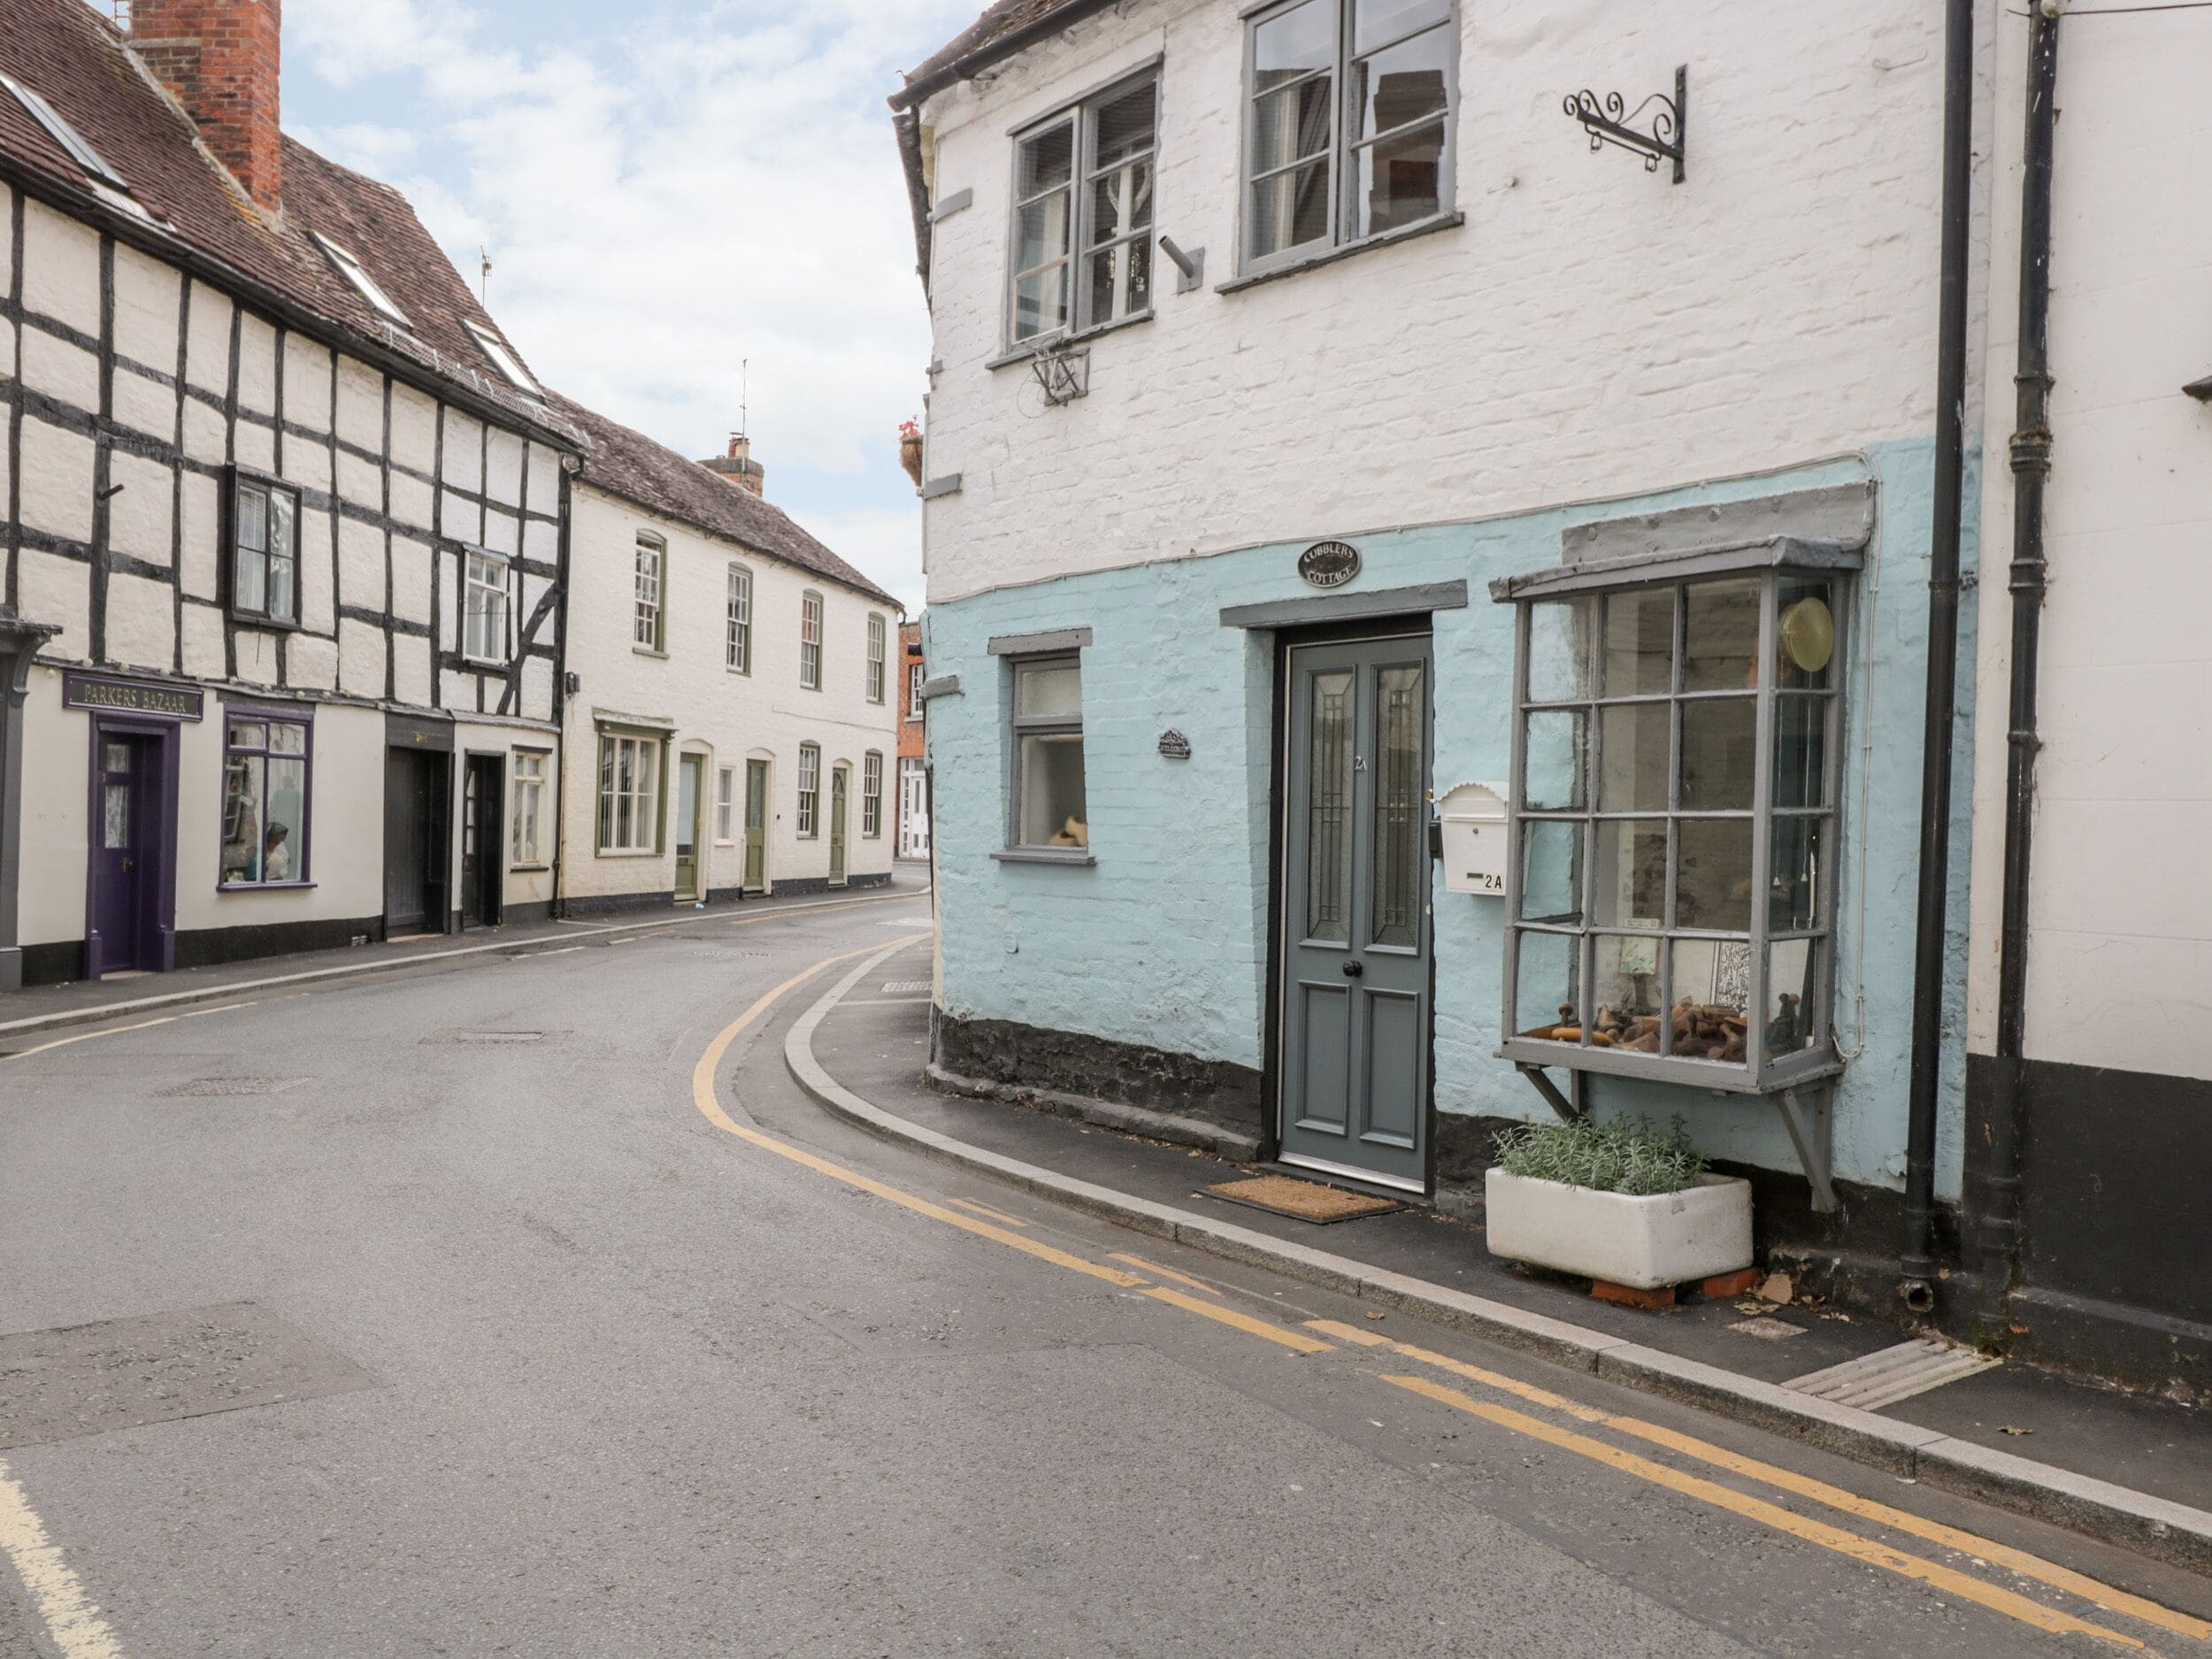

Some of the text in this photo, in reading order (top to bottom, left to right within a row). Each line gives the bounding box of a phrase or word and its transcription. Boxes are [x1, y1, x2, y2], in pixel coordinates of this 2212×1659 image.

[1303, 542, 1354, 563] COBBLERS
[1308, 565, 1352, 584] COTTAGE
[84, 684, 187, 713] PARKERS BAZAAR
[1355, 756, 1367, 771] 2A
